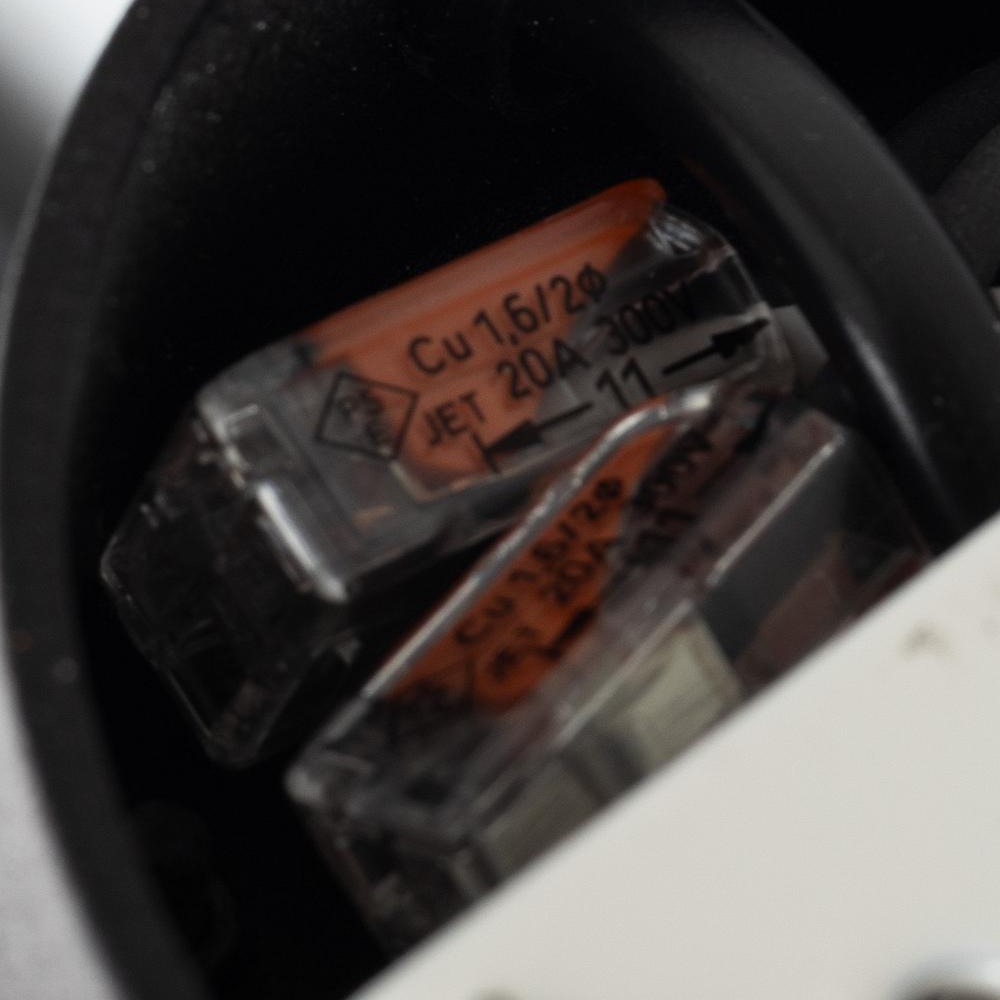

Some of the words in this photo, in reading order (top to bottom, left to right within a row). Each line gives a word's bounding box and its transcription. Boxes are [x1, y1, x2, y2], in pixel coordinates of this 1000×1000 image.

[408, 335, 473, 376] Cu
[422, 391, 486, 446] JET
[496, 338, 591, 399] 20A
